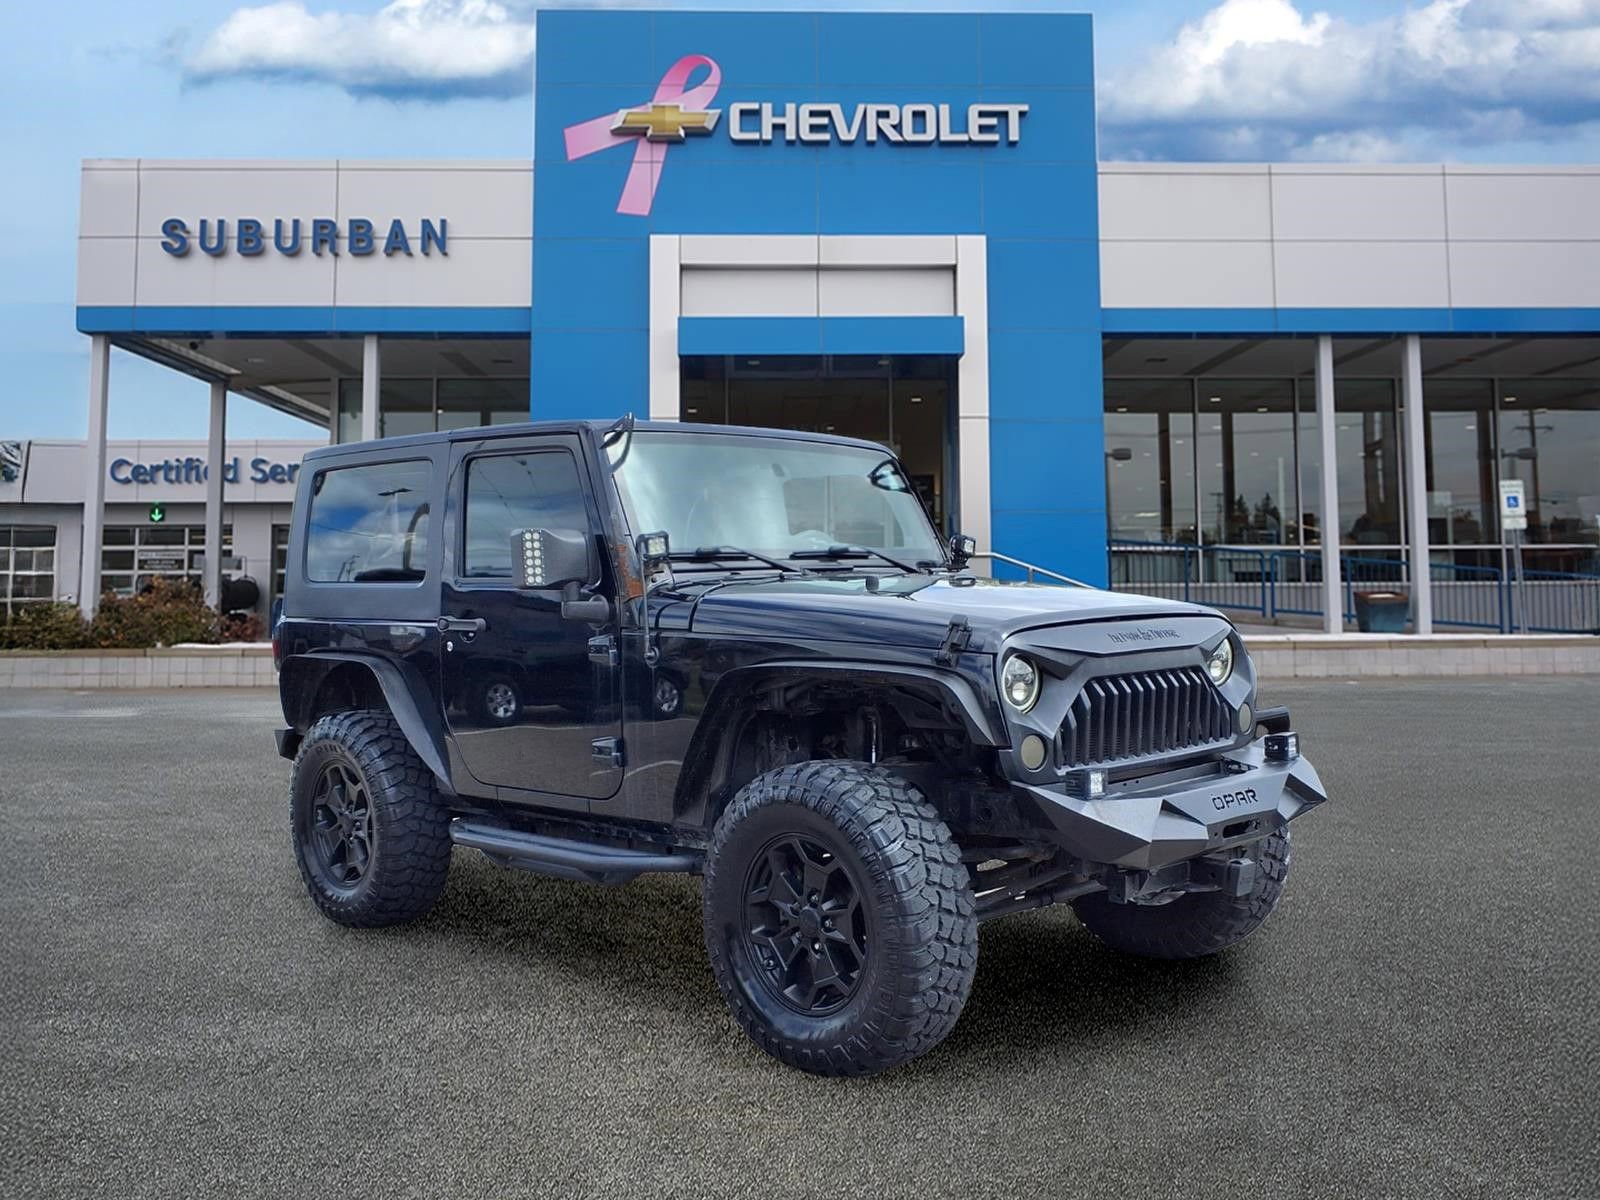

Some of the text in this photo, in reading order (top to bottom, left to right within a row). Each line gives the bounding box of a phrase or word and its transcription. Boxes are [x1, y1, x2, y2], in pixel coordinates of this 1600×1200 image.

[728, 102, 1030, 144] CHEVROLET
[160, 217, 449, 257] SUBURBAN
[110, 457, 241, 484] Certifid
